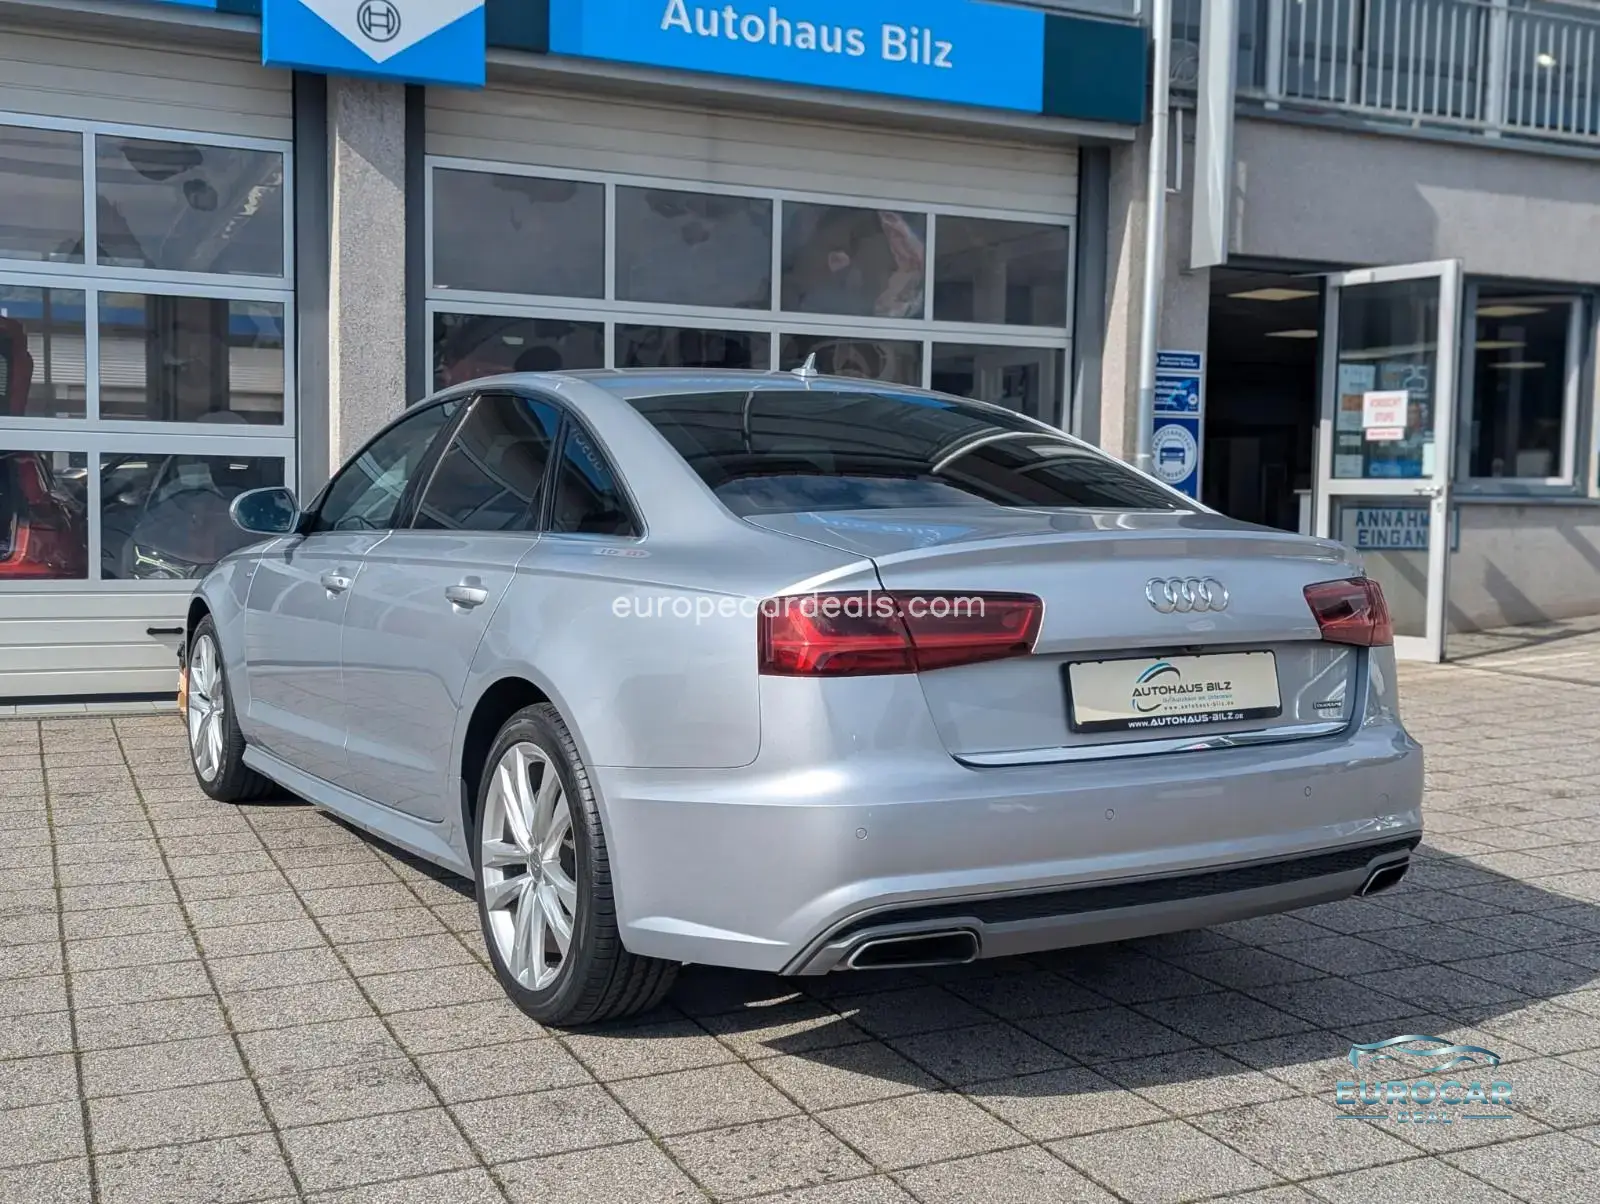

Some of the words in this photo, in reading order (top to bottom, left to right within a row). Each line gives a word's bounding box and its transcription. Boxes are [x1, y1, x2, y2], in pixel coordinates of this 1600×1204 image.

[660, 0, 866, 56] Autohaus
[881, 23, 953, 68] Bilz
[1356, 510, 1431, 527] ANNAHM
[1358, 529, 1428, 545] EINGAN
[1132, 684, 1203, 696] AUTOHAUS
[1206, 681, 1233, 691] BILZ
